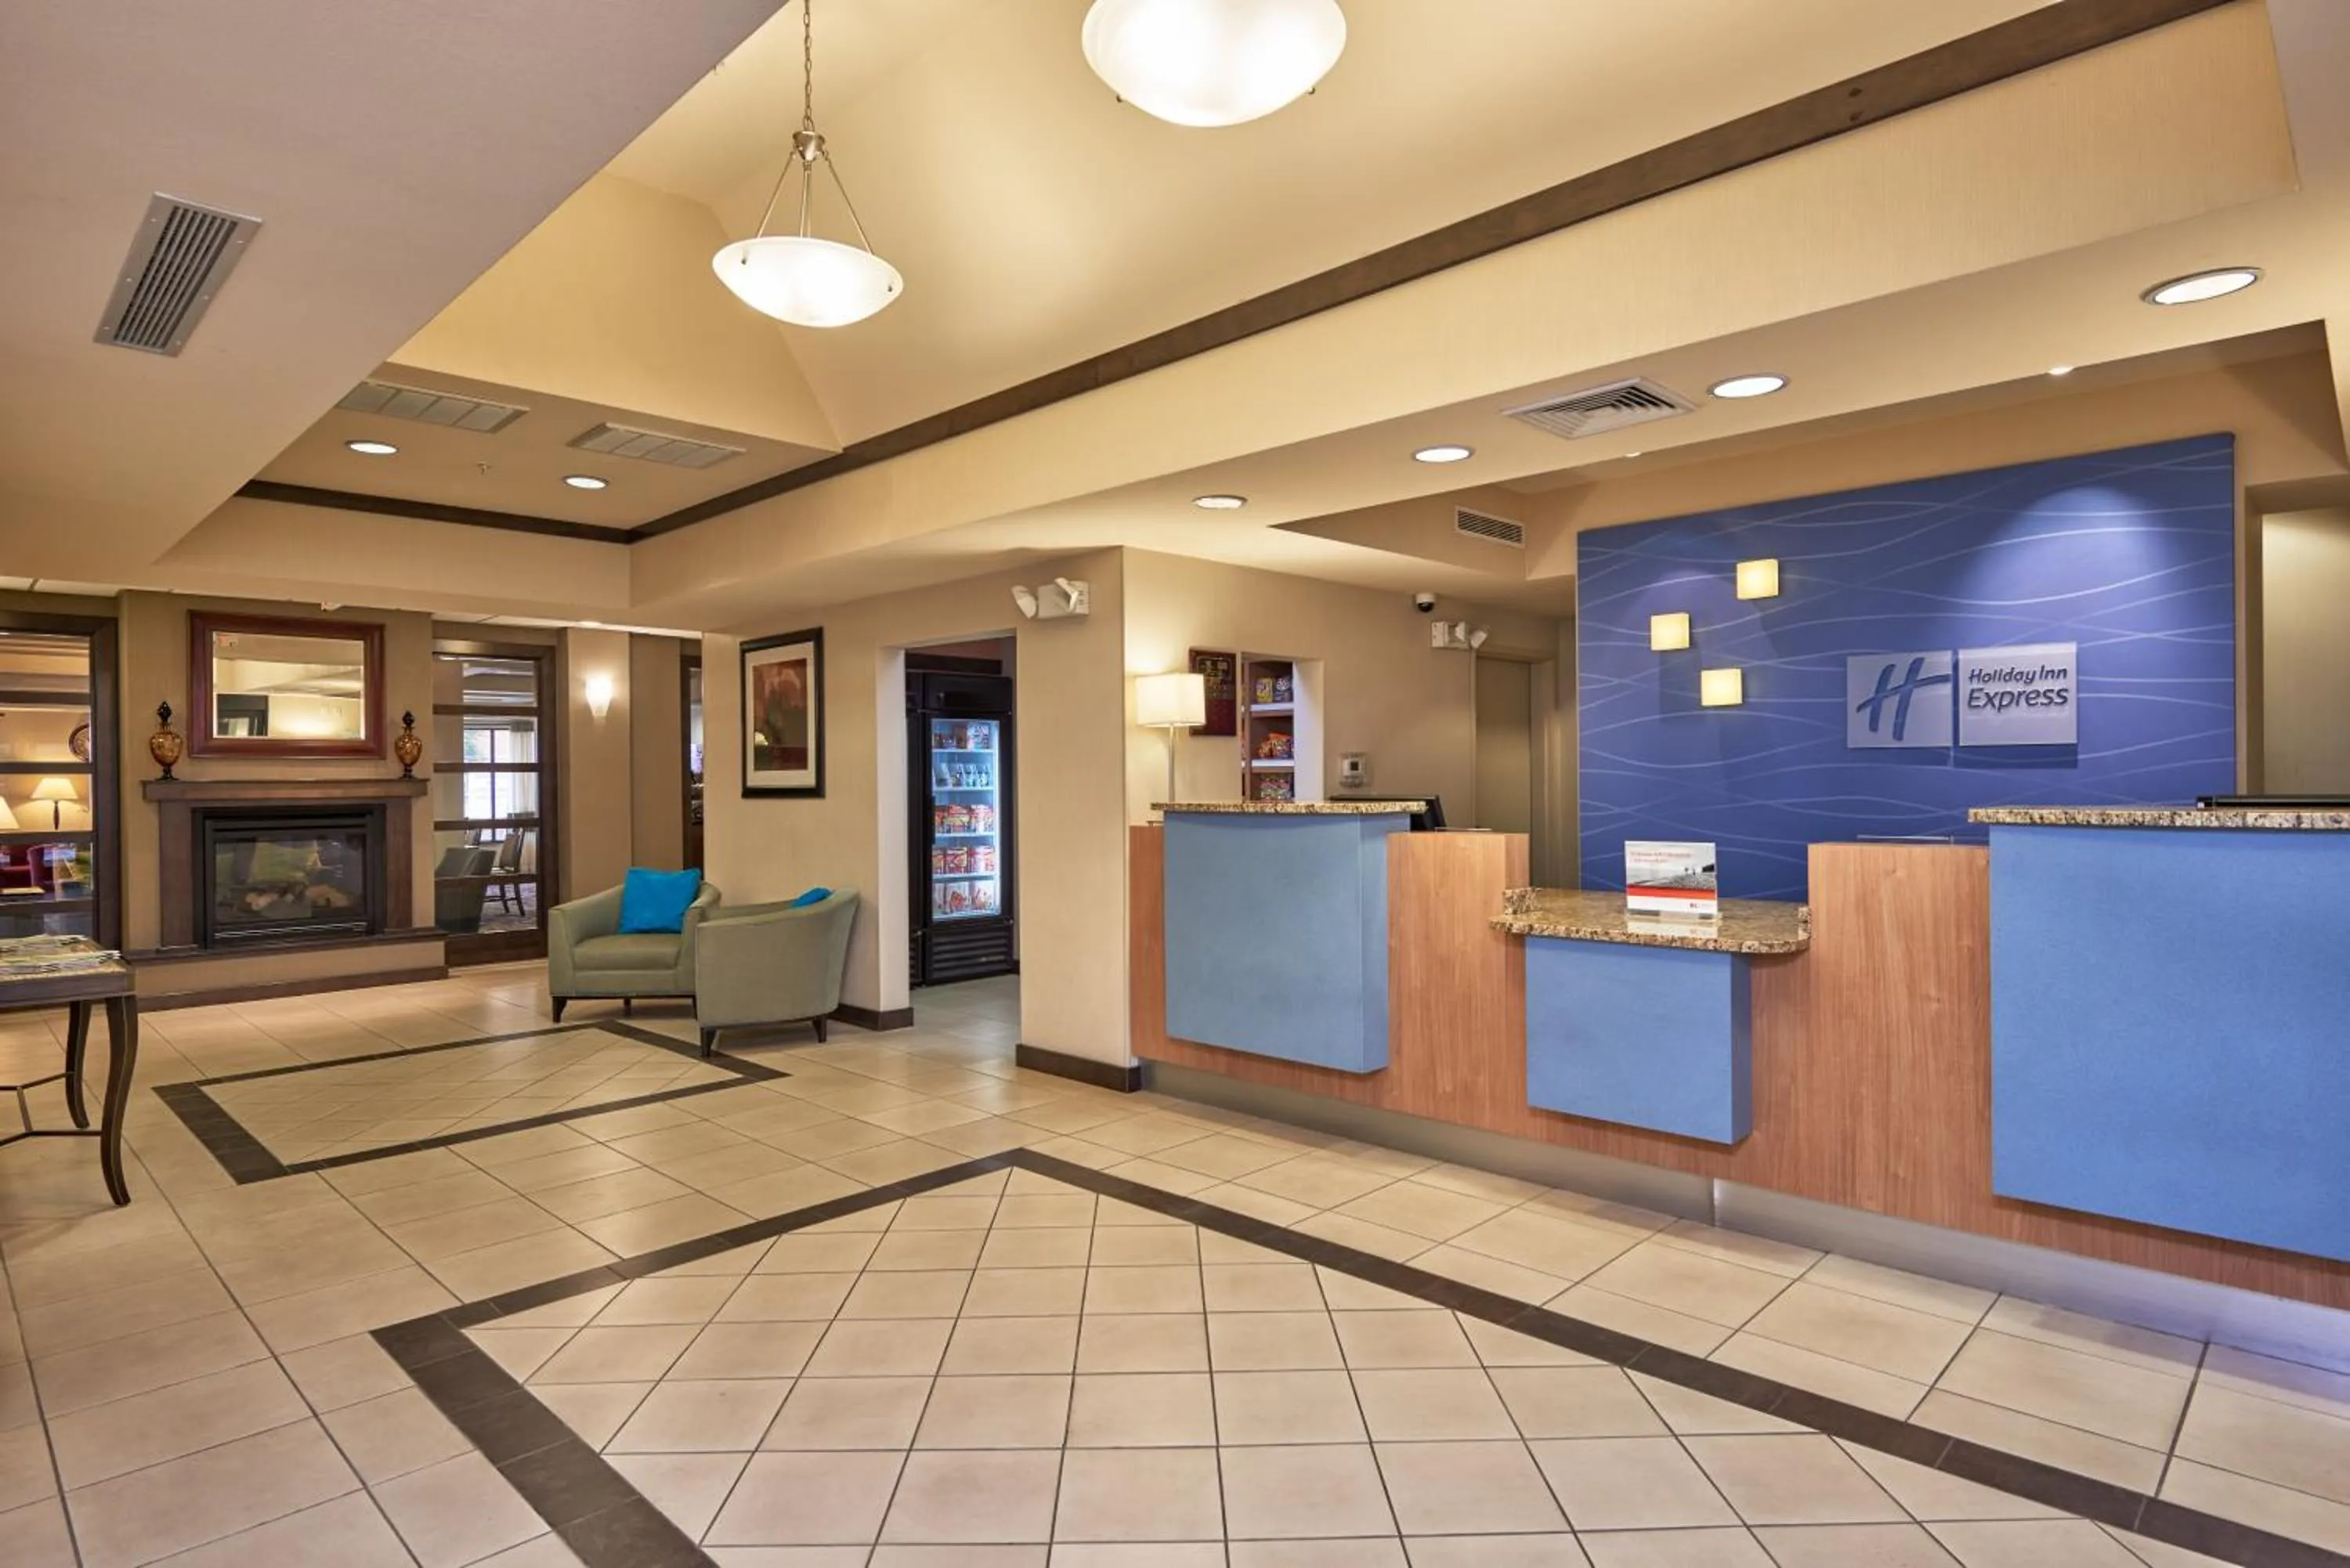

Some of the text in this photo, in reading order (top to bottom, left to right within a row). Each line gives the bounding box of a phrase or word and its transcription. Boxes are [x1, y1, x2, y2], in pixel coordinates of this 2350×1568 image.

[1968, 664, 2068, 685] Holiday Inn
[1967, 687, 2069, 713] Express
